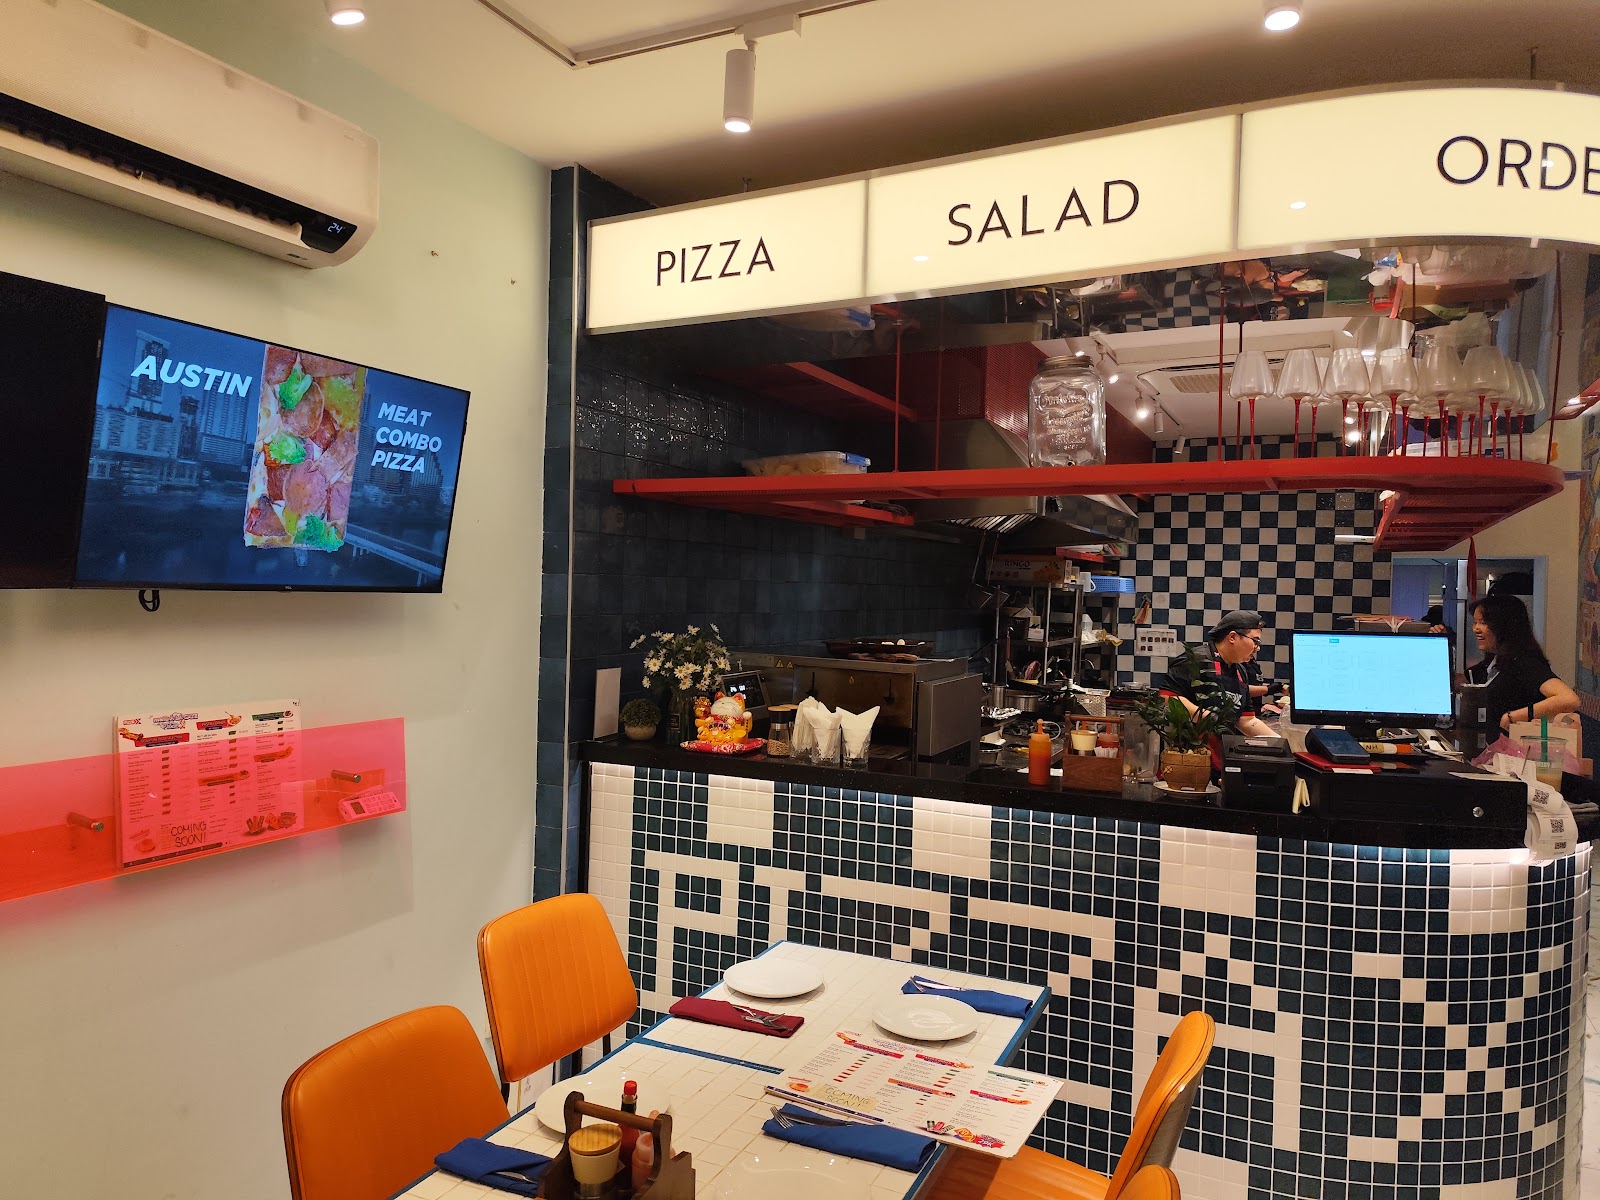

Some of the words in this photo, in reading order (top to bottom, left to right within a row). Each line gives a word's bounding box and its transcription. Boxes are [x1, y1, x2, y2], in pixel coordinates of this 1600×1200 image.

[1436, 135, 1600, 196] ORDE
[948, 179, 1140, 247] SALAD
[656, 236, 777, 287] PIZZA
[131, 356, 253, 397] AUSTIN
[378, 402, 432, 427] MEAT
[376, 427, 443, 453] COMBO
[371, 450, 426, 474] PIZZA
[171, 822, 207, 837] COMING
[174, 833, 207, 848] SOON!
